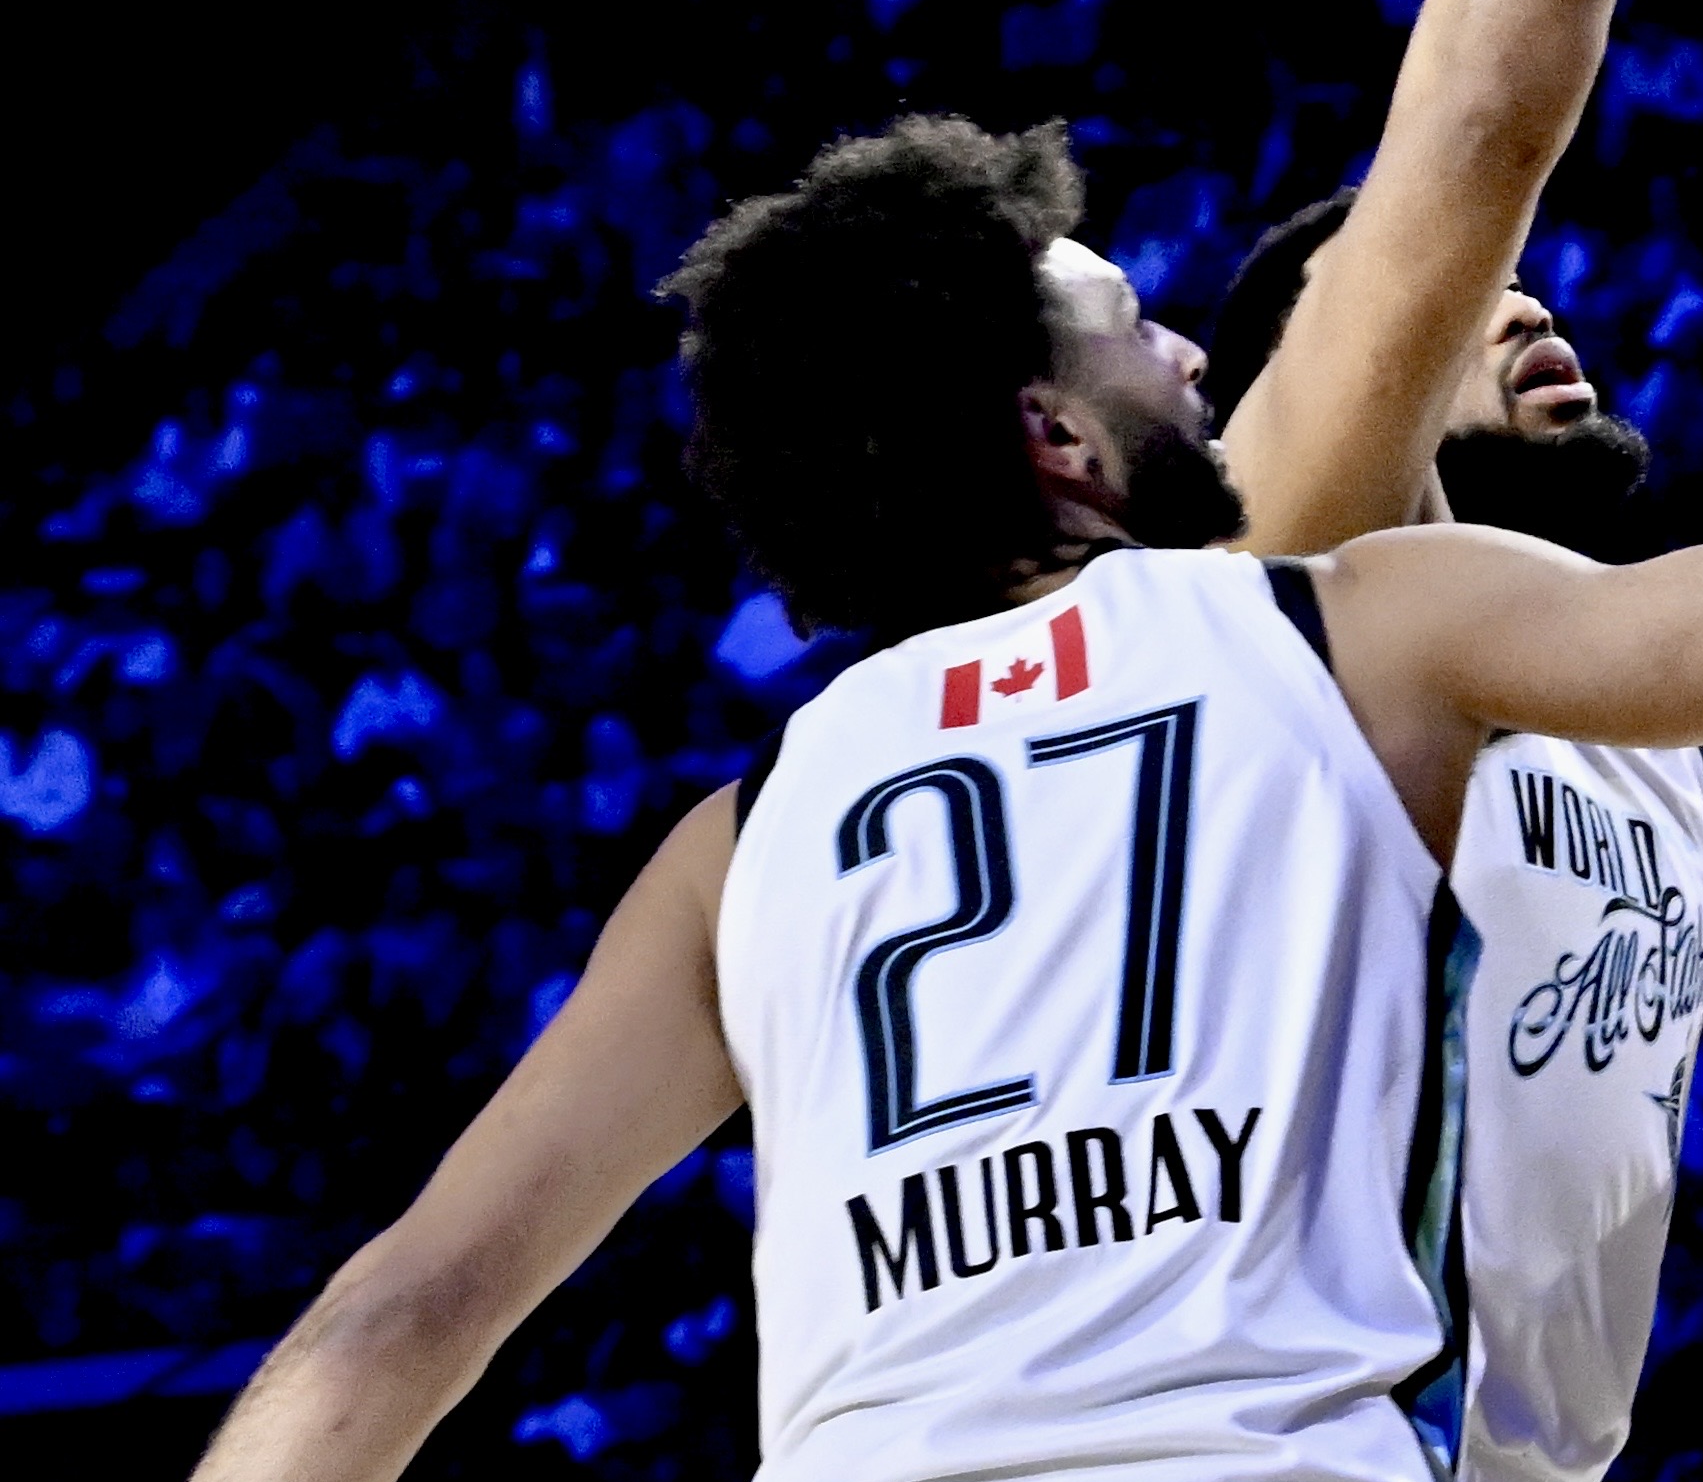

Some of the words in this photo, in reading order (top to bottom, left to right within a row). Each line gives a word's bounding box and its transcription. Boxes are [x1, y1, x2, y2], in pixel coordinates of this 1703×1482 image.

[834, 693, 1207, 1159] 27
[1510, 768, 1664, 911] WORLD
[845, 1107, 1262, 1315] MURRAY
